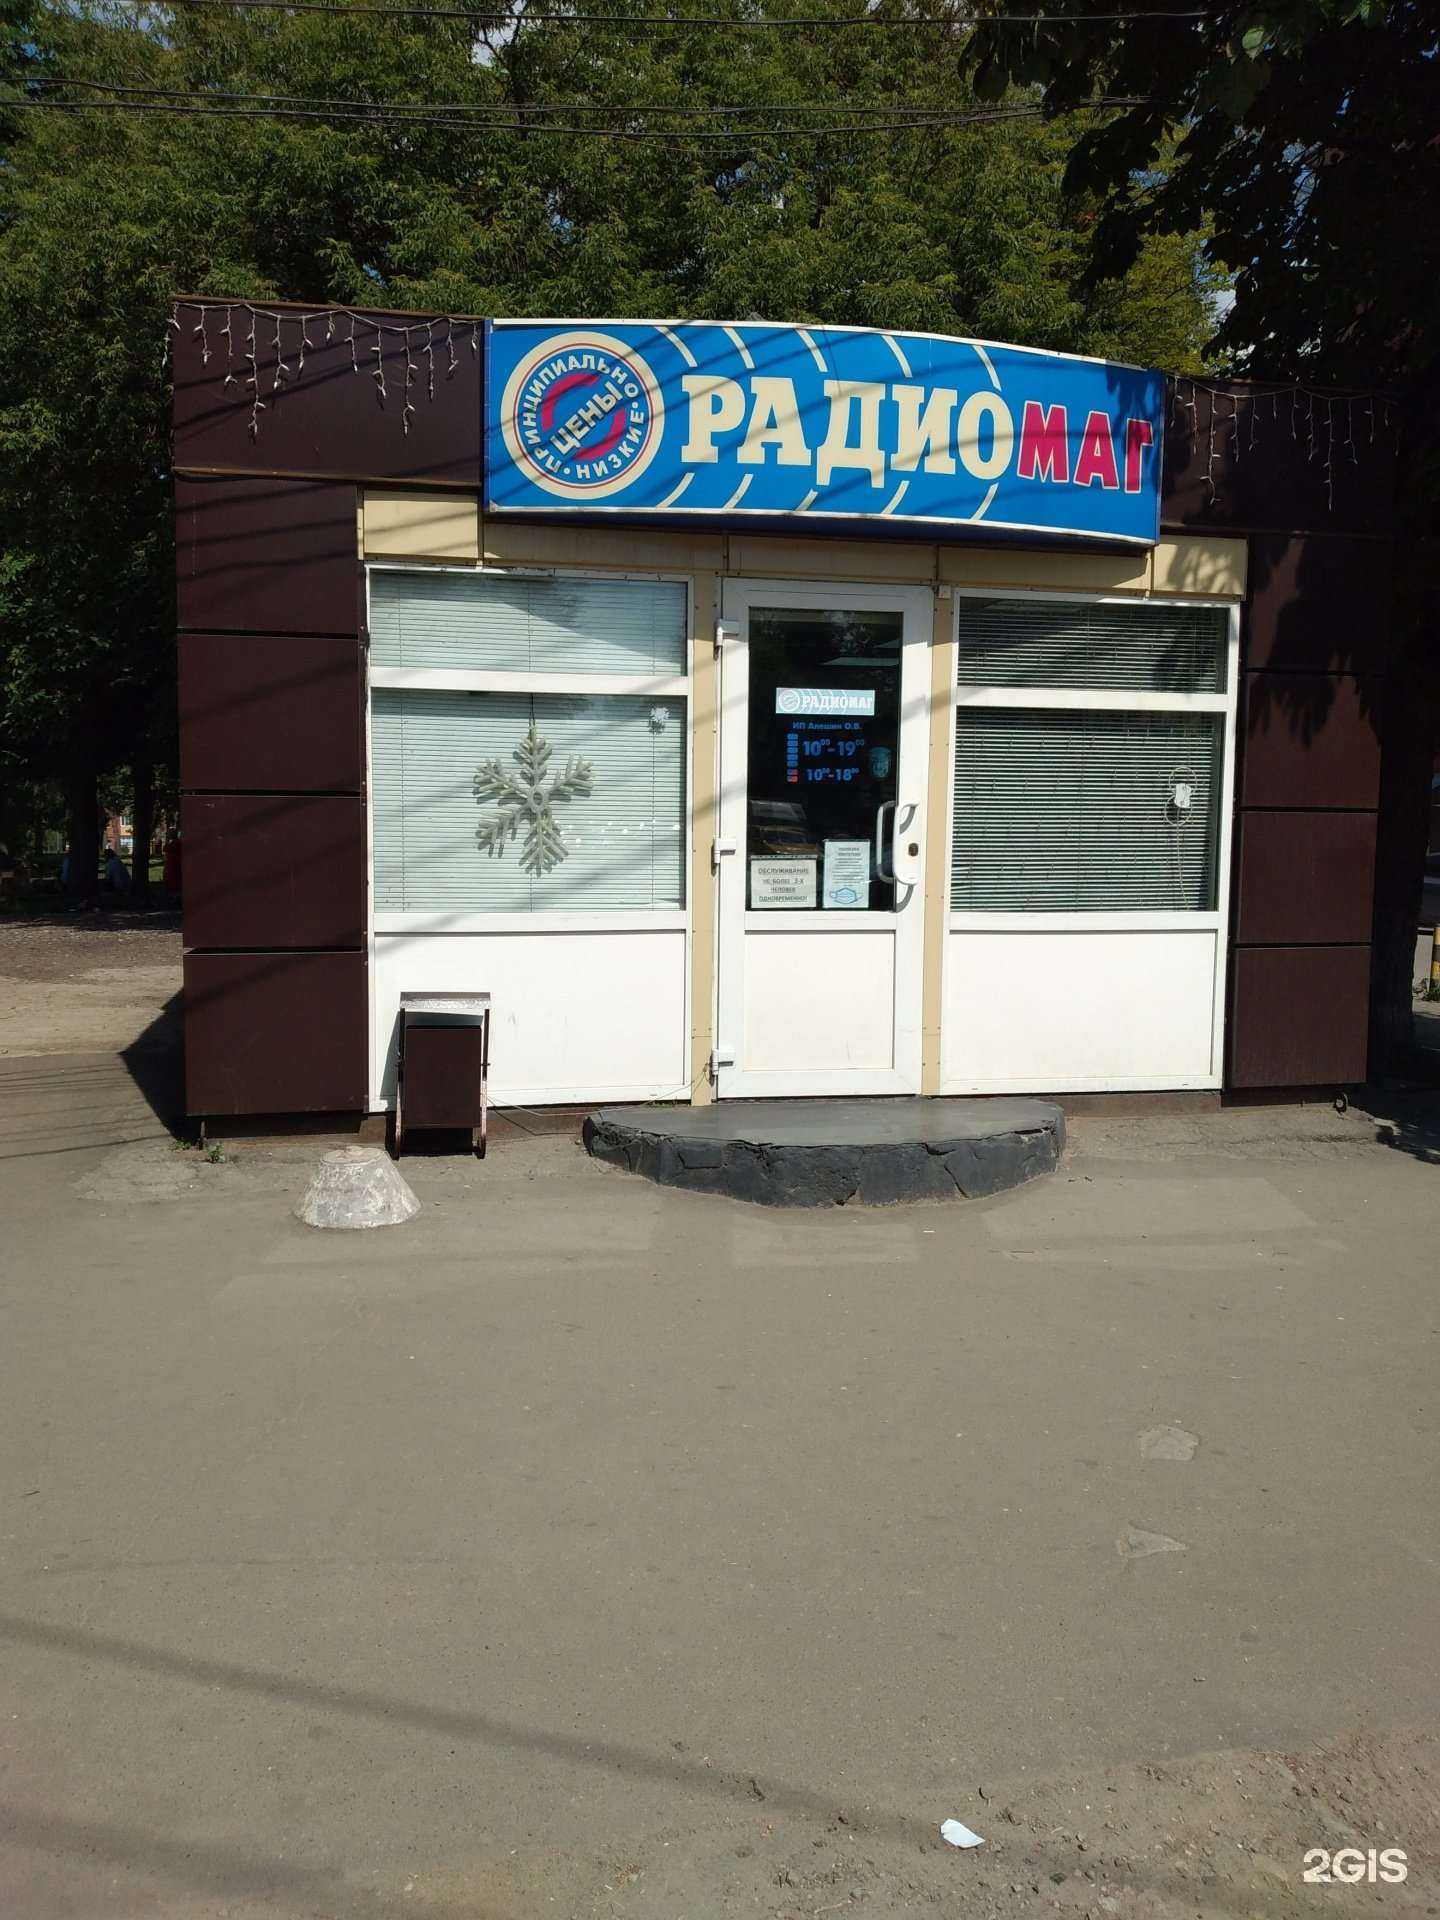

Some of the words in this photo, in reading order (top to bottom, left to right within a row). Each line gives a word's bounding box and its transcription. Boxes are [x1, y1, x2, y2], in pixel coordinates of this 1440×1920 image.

[521, 354, 640, 474] ПРИНЦИПИАЛЬНО
[550, 381, 624, 456] ЦЕНЫ
[575, 409, 644, 480] НИЗКИЕ
